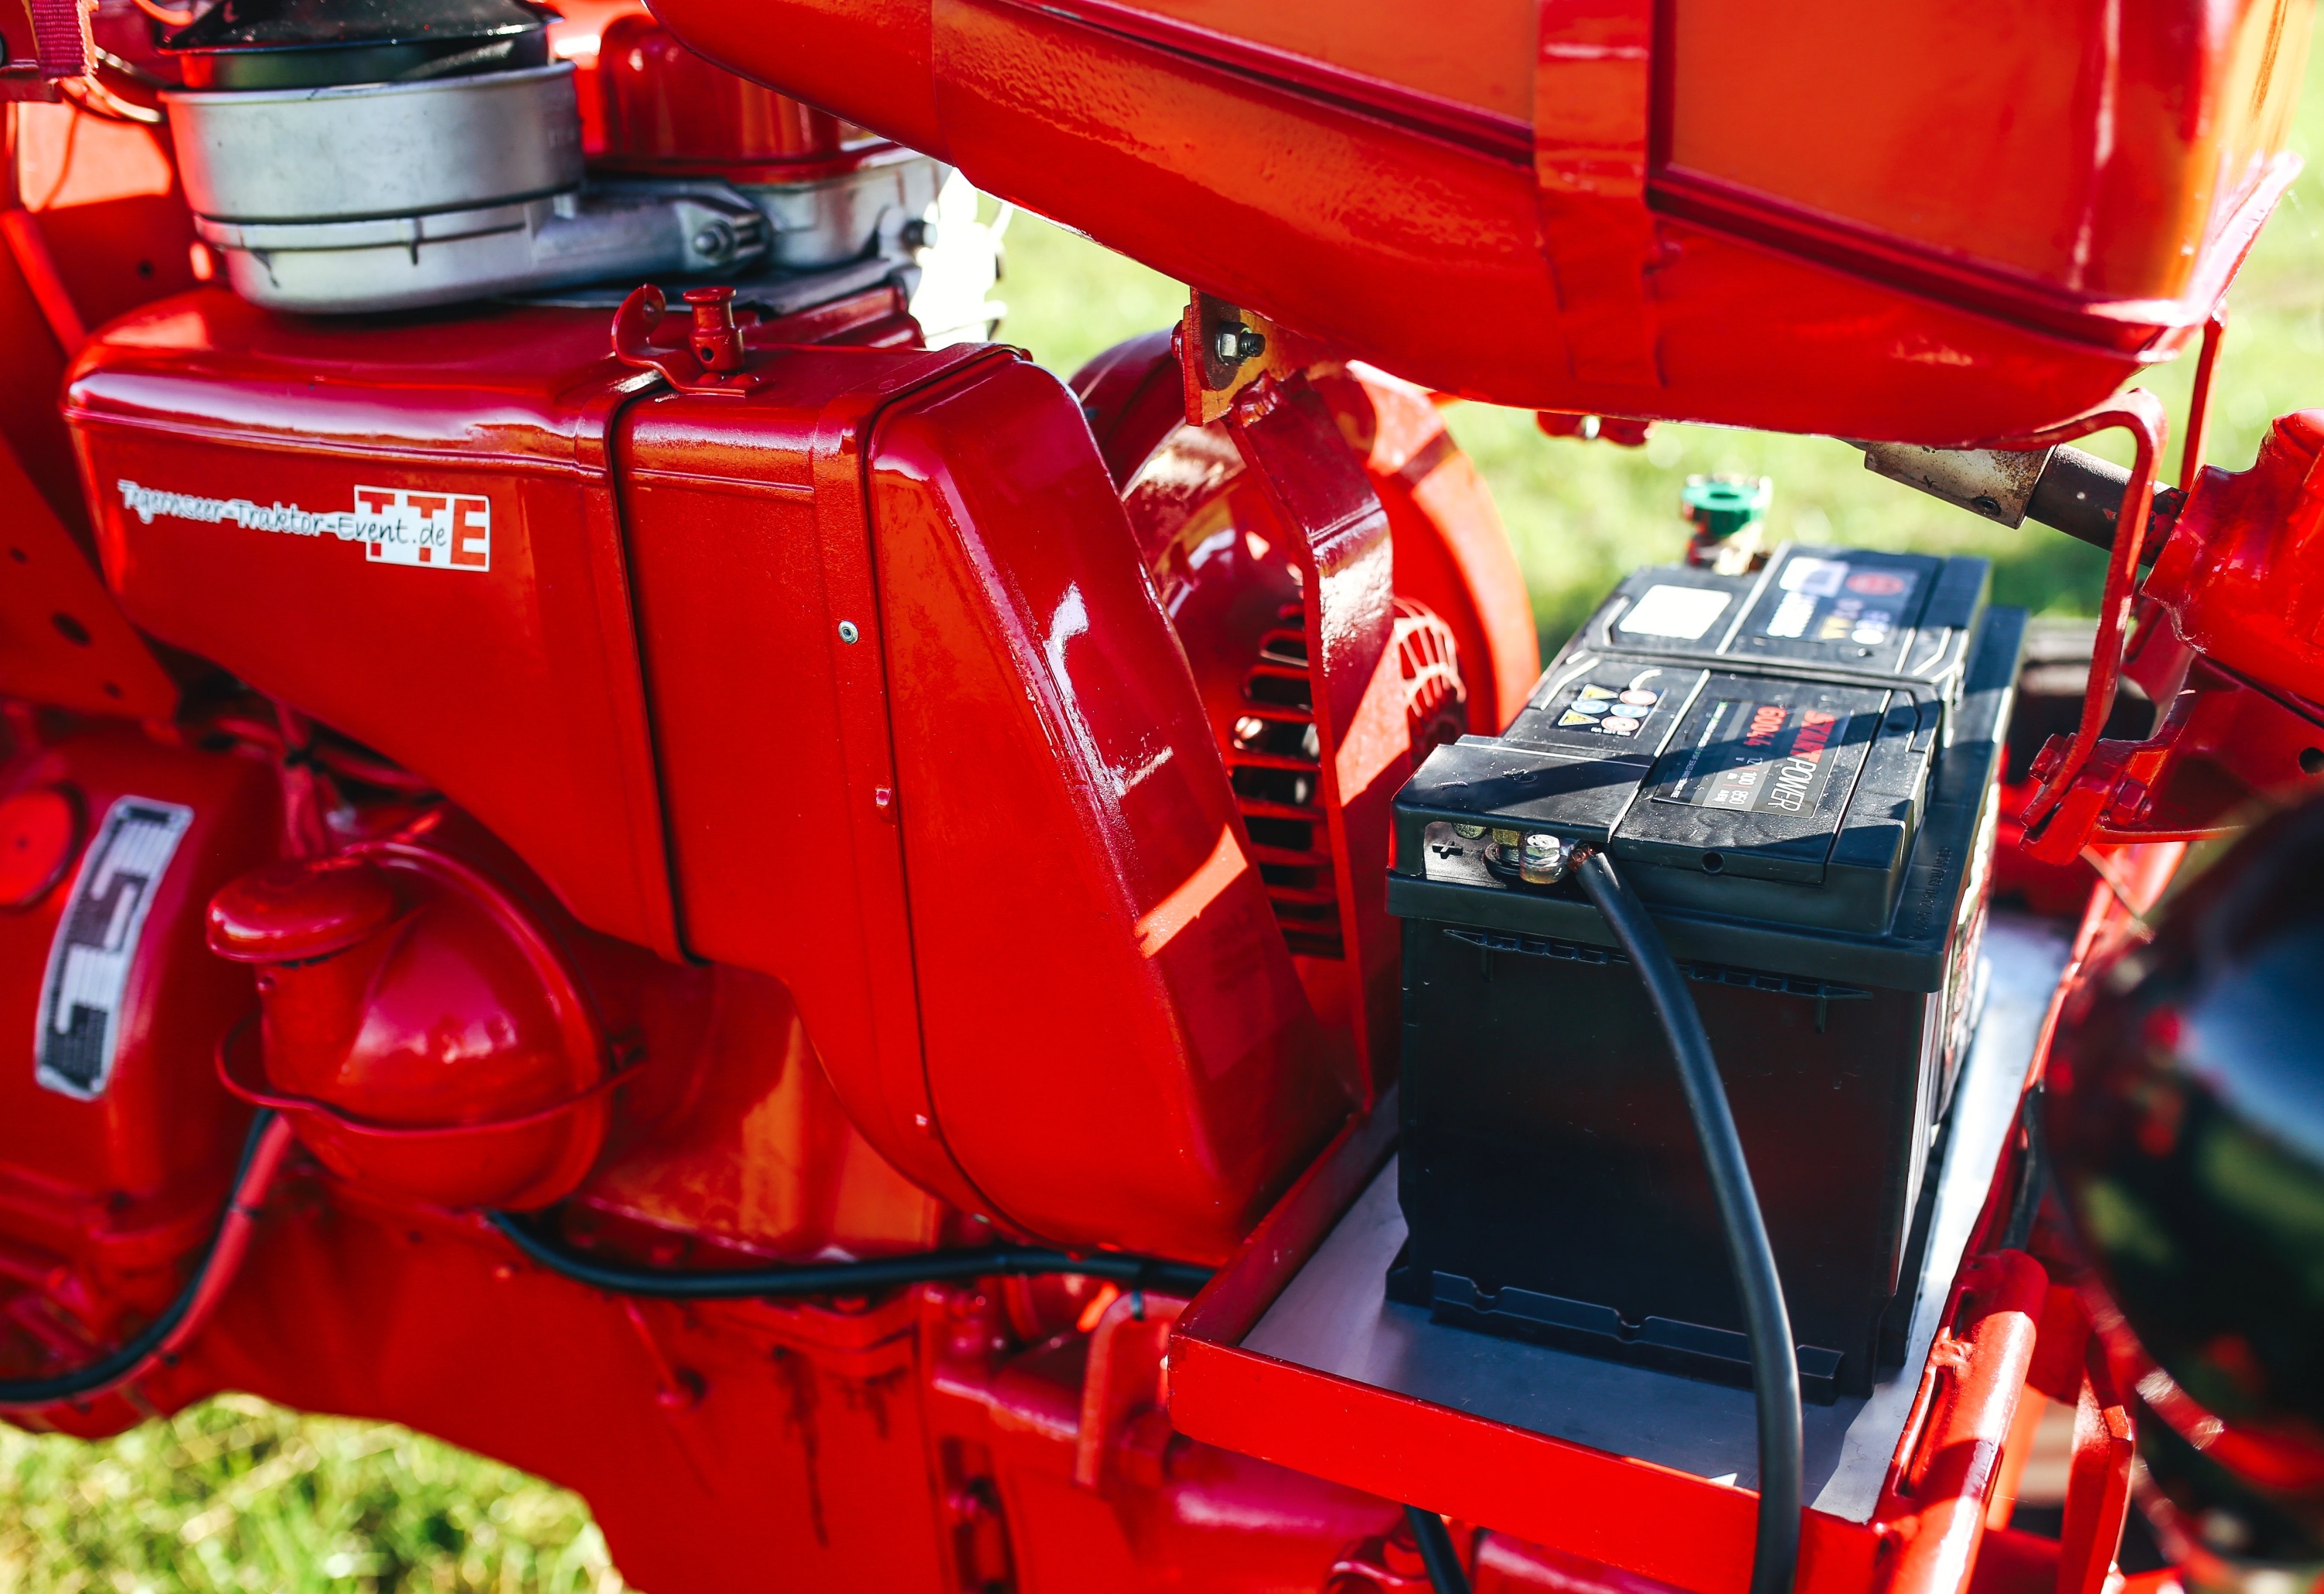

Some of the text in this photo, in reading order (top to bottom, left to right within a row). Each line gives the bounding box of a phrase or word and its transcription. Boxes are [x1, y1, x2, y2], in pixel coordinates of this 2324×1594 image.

[358, 491, 486, 567] TTE
[1744, 706, 1787, 746] 60044
[1728, 757, 1763, 805] 12 100 850
